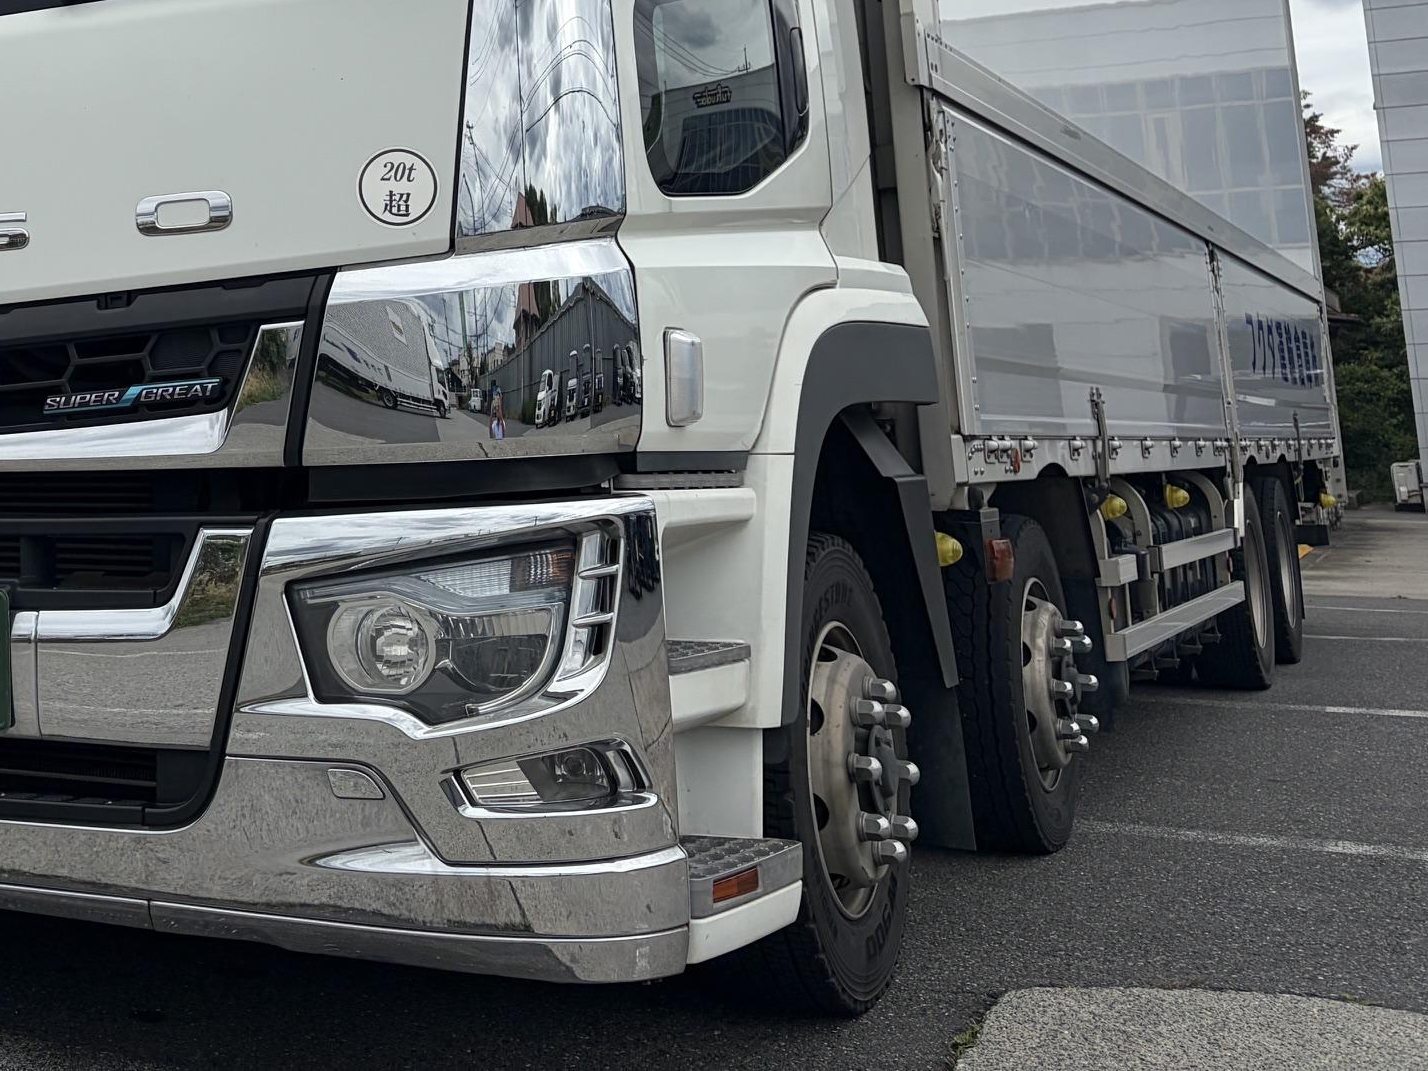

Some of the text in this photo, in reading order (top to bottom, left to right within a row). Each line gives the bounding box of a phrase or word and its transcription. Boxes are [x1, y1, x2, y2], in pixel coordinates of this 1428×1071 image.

[380, 161, 417, 183] 20t
[382, 190, 412, 217] 超
[44, 382, 219, 410] SUPER GREAT
